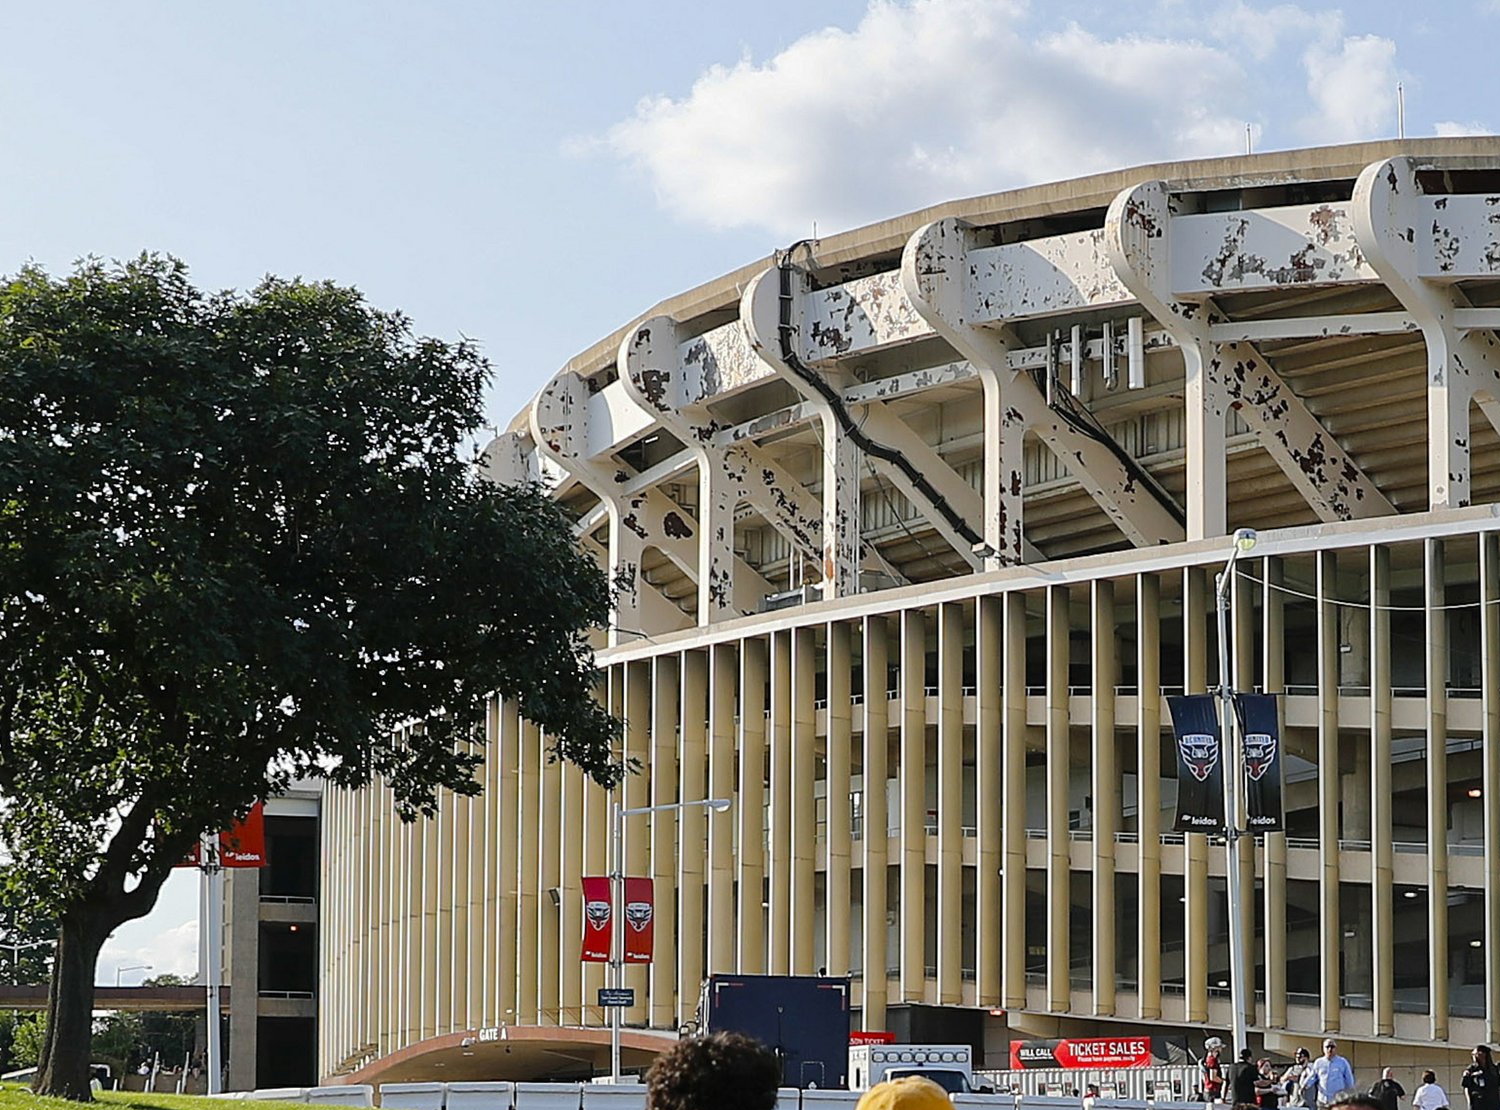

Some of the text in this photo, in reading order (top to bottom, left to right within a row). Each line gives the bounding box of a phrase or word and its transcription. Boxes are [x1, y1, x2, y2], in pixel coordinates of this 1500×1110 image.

[1191, 816, 1218, 825] leidos
[1019, 1048, 1053, 1057] WILL CALL
[1068, 1041, 1146, 1056] TICKET SALES
